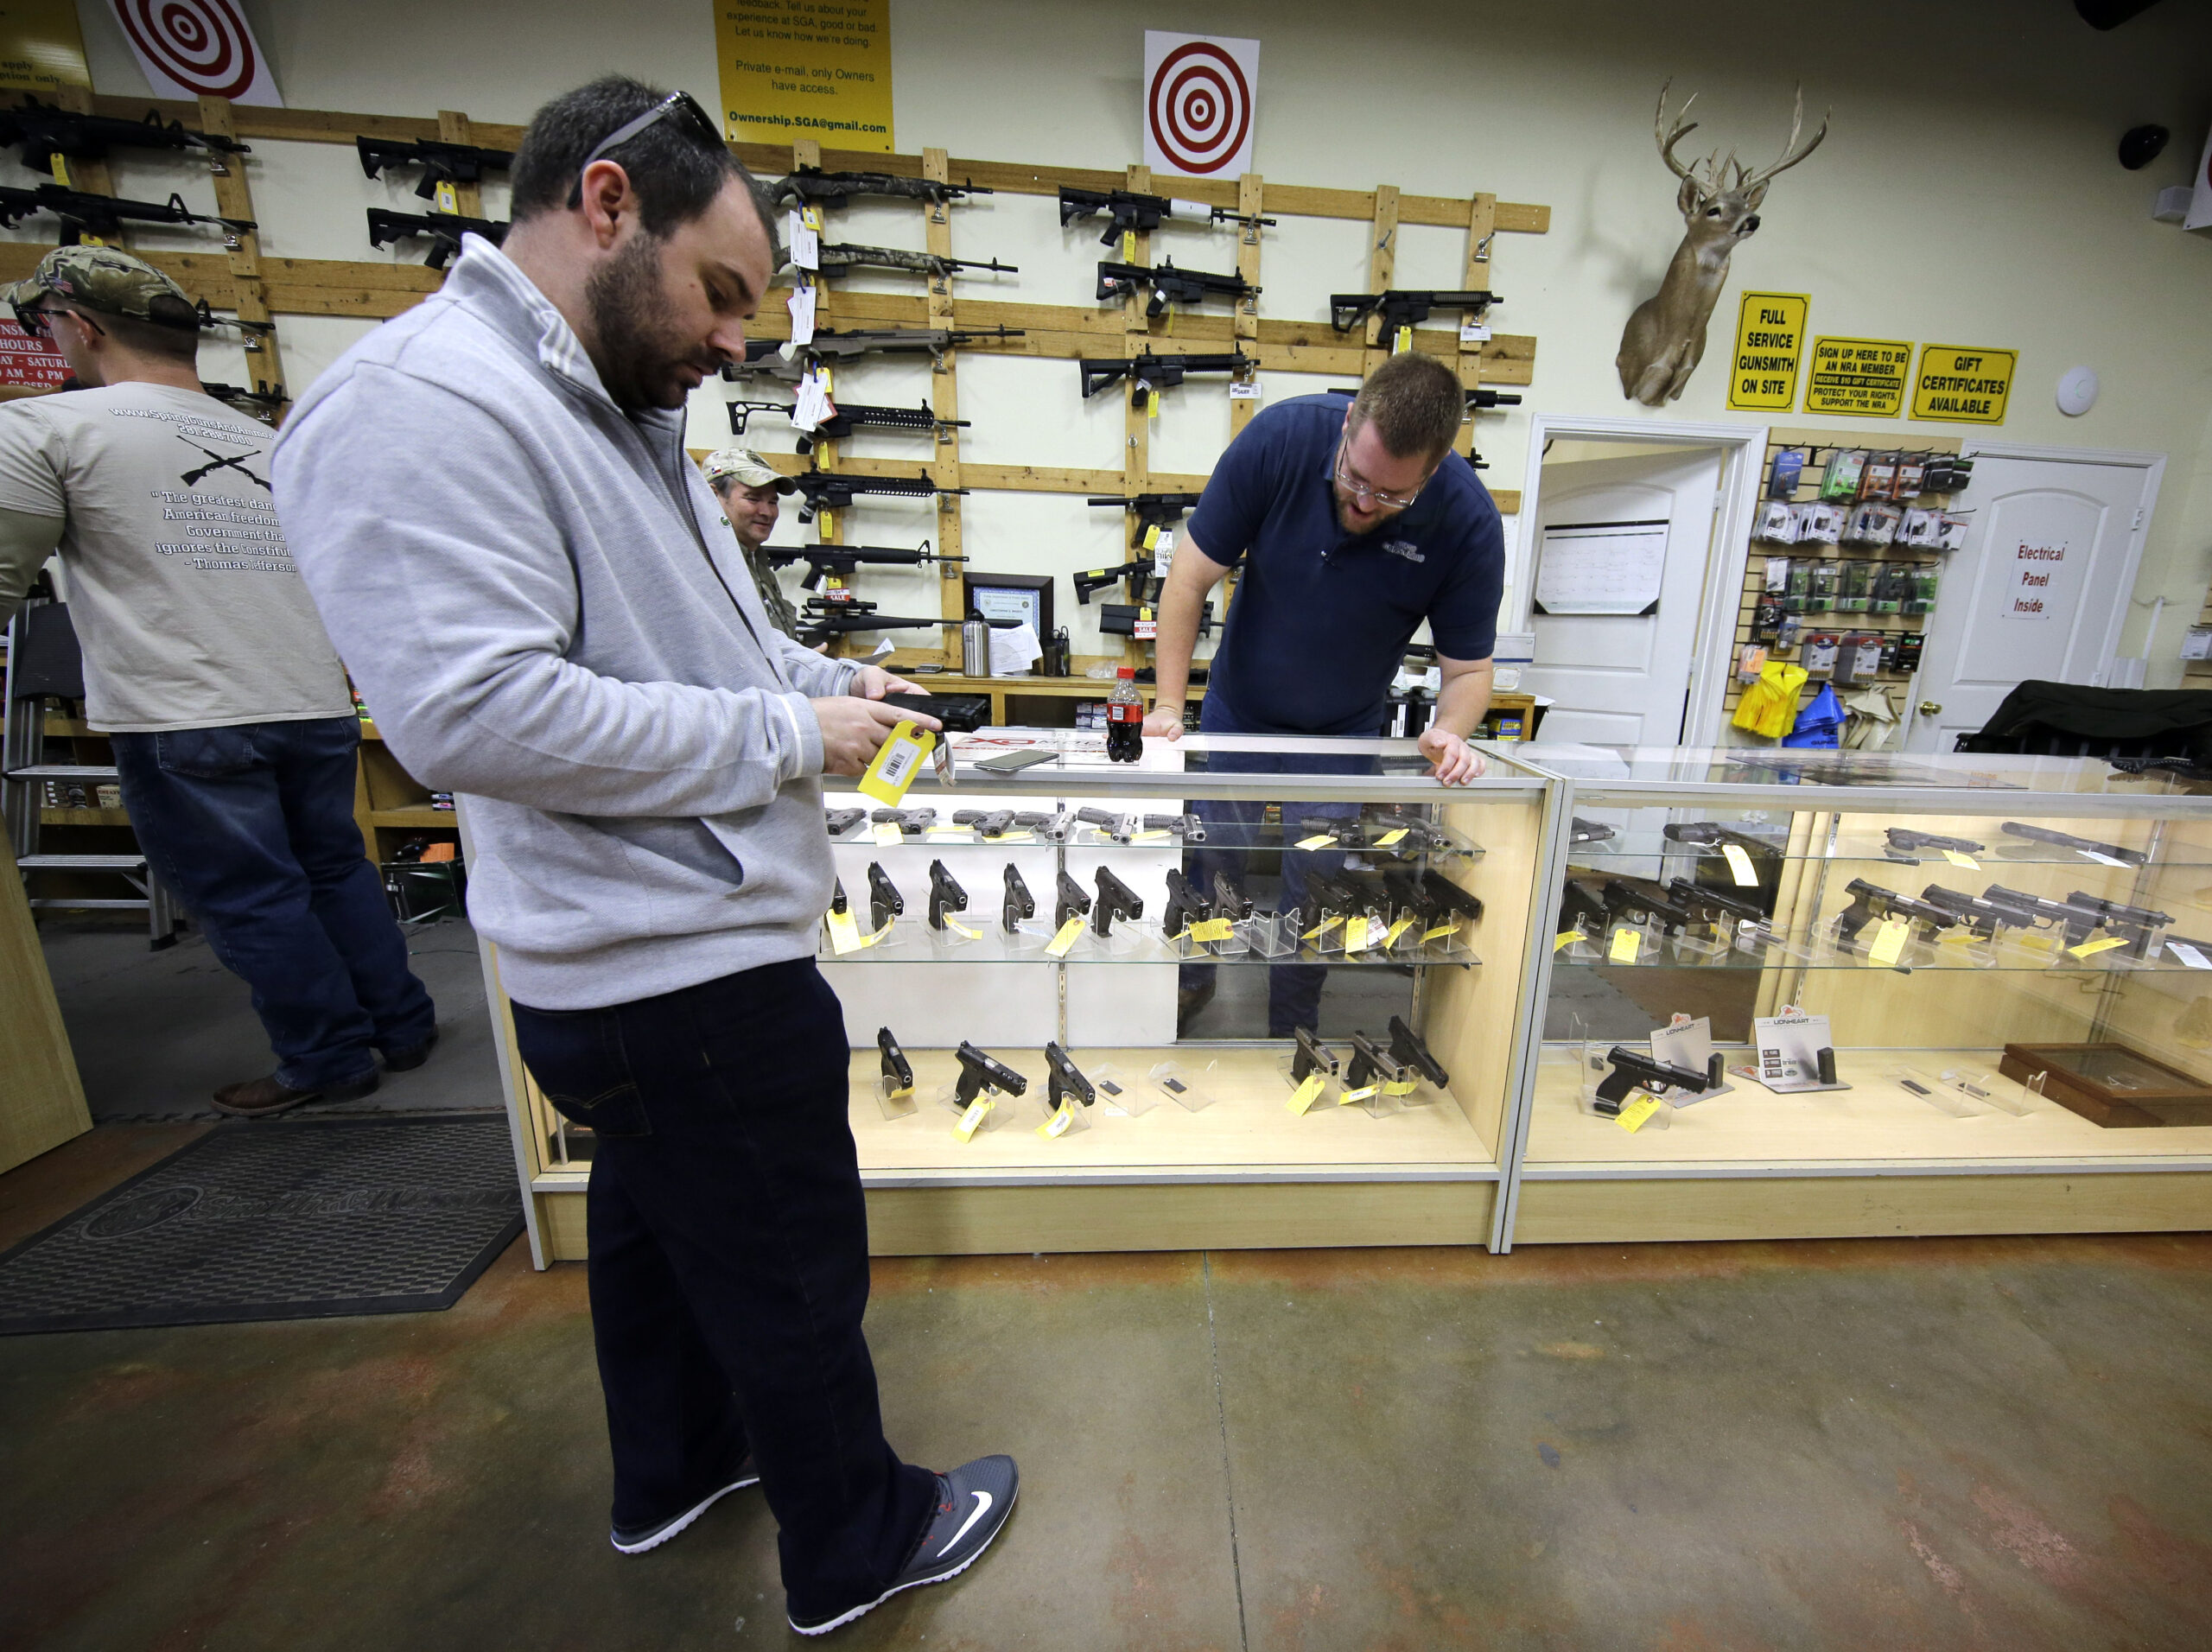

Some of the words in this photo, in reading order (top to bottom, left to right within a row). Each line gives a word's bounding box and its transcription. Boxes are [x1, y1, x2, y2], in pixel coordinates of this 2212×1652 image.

[787, 0, 801, 10] Tell
[818, 4, 843, 15] about
[847, 9, 867, 17] your
[727, 12, 779, 24] experience
[781, 16, 790, 25] at
[793, 16, 817, 29] SGA,
[820, 20, 843, 30] good
[858, 22, 878, 33] bad.
[735, 25, 750, 36] Let
[753, 29, 764, 38] us
[767, 29, 791, 40] know
[794, 31, 813, 41] how
[816, 35, 841, 44] we're
[843, 36, 871, 48] doing.
[2, 60, 33, 71] apply
[735, 60, 772, 73] Private
[810, 68, 832, 80] only
[836, 69, 874, 82] Owners
[772, 79, 797, 91] have
[799, 84, 838, 95] access.
[729, 111, 887, 133] Ownership.SGA@gmail.com
[1760, 309, 1786, 325] FULL
[0, 339, 43, 352] HOURS
[1747, 332, 1794, 348] SERVICE
[1819, 347, 1839, 359] SIGN
[1841, 348, 1853, 359] UP
[1856, 350, 1878, 361] HERE
[1882, 352, 1892, 362] TO
[1895, 353, 1906, 363] BE
[1739, 355, 1795, 372] GUNSMITH
[1825, 361, 1838, 372] AN
[1840, 362, 1857, 373] NRA
[1860, 363, 1896, 375] MEMBER
[1955, 356, 1983, 372] GIFT
[7, 368, 24, 378] AM
[37, 370, 44, 379] 6
[47, 370, 64, 380] PM
[1816, 375, 1840, 384] RECEIVE
[1866, 378, 1900, 388] CERTIFICATE
[1742, 378, 1758, 394] ON
[1761, 379, 1785, 395] SITE
[1922, 375, 2005, 395] CERTIFICATES
[1814, 387, 1847, 397] PROTECT
[1849, 389, 1868, 398] YOUR
[1871, 391, 1897, 401] RIGHTS,
[1821, 397, 1854, 408] SUPPORT
[1857, 400, 1870, 409] THE
[1872, 401, 1886, 410] NRA
[1928, 397, 1992, 415] AVAILABLE
[162, 491, 188, 504] The
[192, 492, 246, 508] greatest
[163, 508, 229, 522] American
[231, 511, 282, 527] freedom
[186, 525, 262, 541] Government
[155, 541, 213, 555] ignores
[215, 542, 239, 555] the
[2018, 544, 2065, 561] Electrical
[193, 558, 249, 570] Thomas
[2022, 571, 2050, 587] Panel
[2013, 597, 2044, 613] Inside
[1666, 1023, 1694, 1036] LIONHEART
